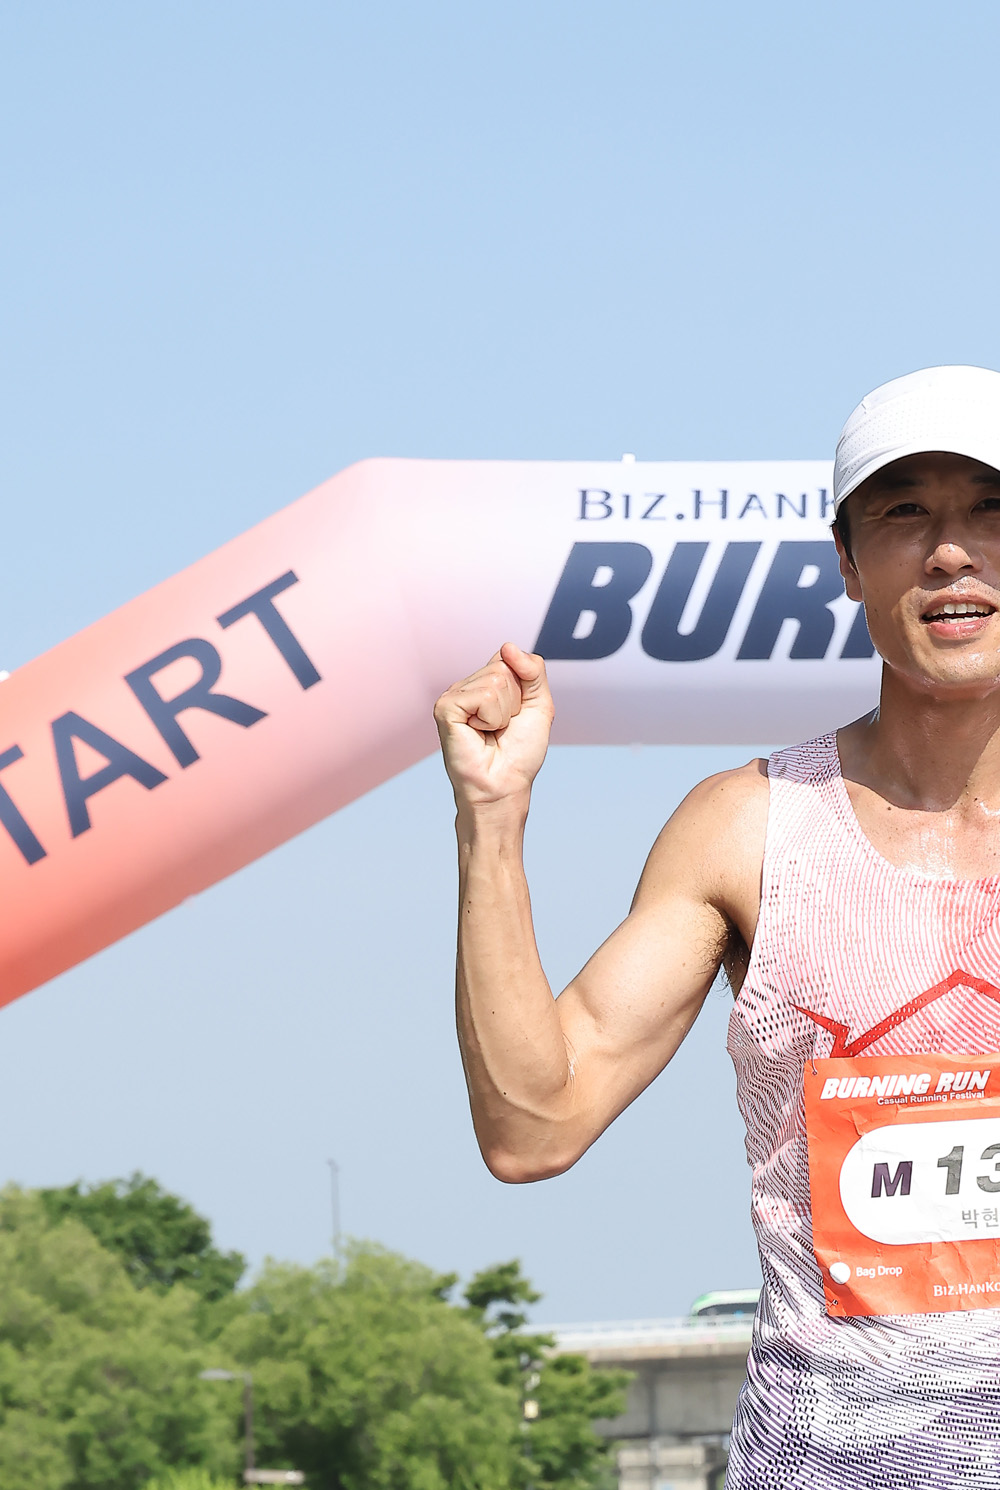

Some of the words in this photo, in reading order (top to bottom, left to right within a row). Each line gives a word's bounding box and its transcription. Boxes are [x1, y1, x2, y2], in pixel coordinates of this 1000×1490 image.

[820, 1071, 931, 1100] BURNING
[932, 1070, 991, 1092] RUN
[877, 1095, 908, 1106] Casual
[910, 1093, 948, 1104] Running
[949, 1090, 985, 1101] Festival
[871, 1160, 914, 1199] M
[856, 1266, 876, 1279] Bag
[877, 1264, 903, 1279] Drop
